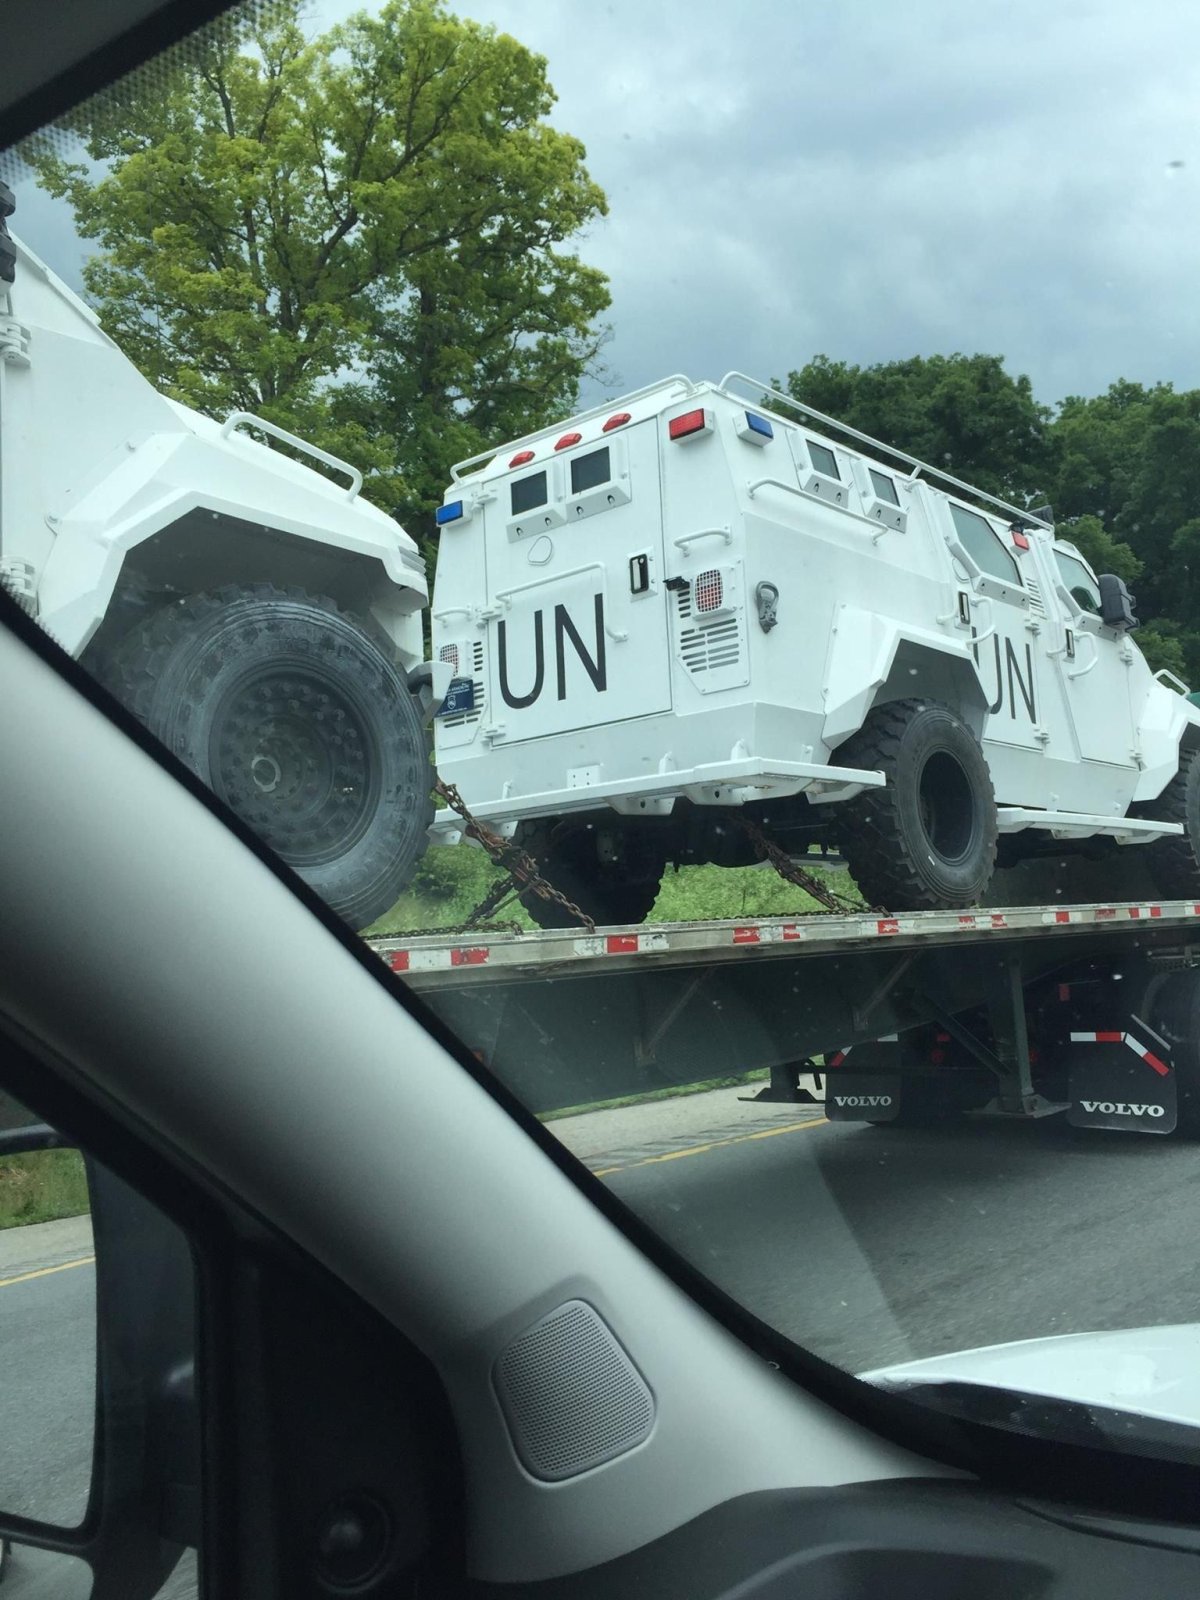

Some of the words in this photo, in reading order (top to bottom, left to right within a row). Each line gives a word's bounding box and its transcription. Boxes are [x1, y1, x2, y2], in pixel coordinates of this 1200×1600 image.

[498, 593, 607, 709] UN
[834, 1096, 891, 1106] VOLVO
[1080, 1101, 1165, 1117] VOLVO
